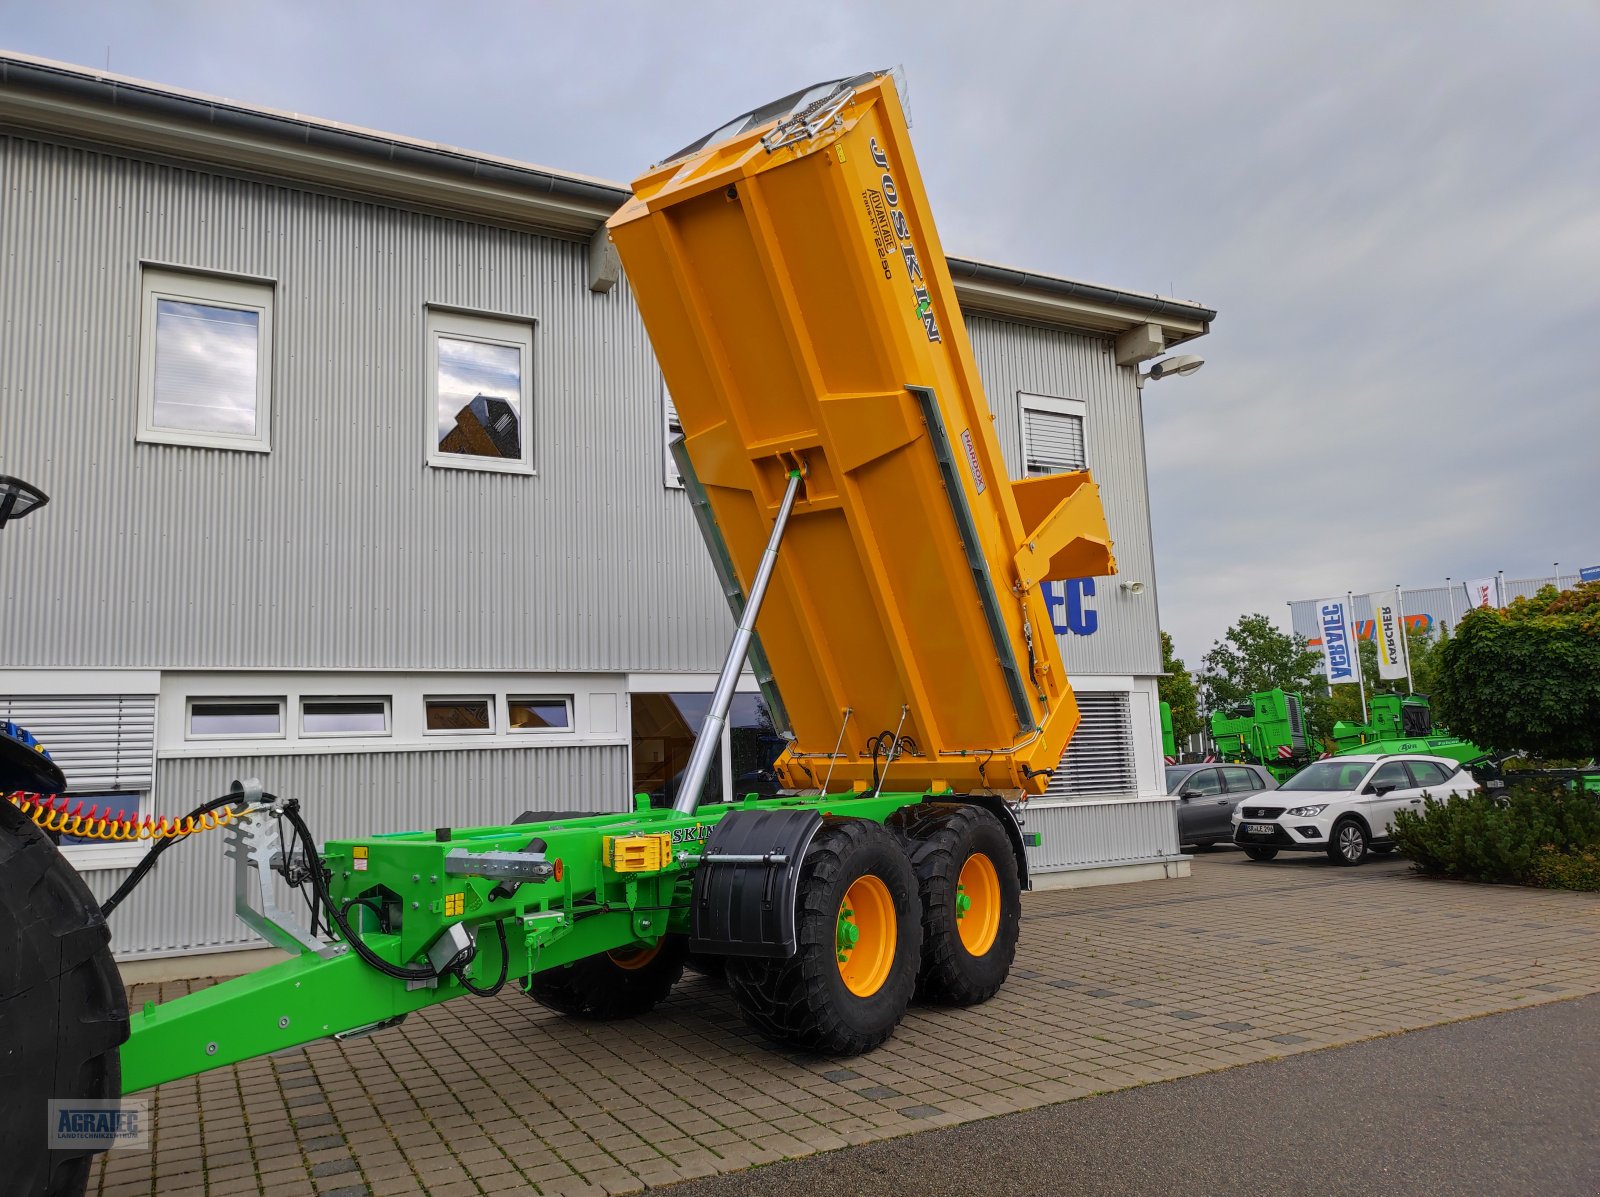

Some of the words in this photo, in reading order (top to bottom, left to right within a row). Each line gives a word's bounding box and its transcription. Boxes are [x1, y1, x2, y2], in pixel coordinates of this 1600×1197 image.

[867, 188, 896, 250] ADVANTAGE
[869, 136, 942, 344] JOSKIN
[875, 238, 892, 280] 22/50
[964, 434, 984, 486] HARDOX
[661, 824, 717, 843] SKIN
